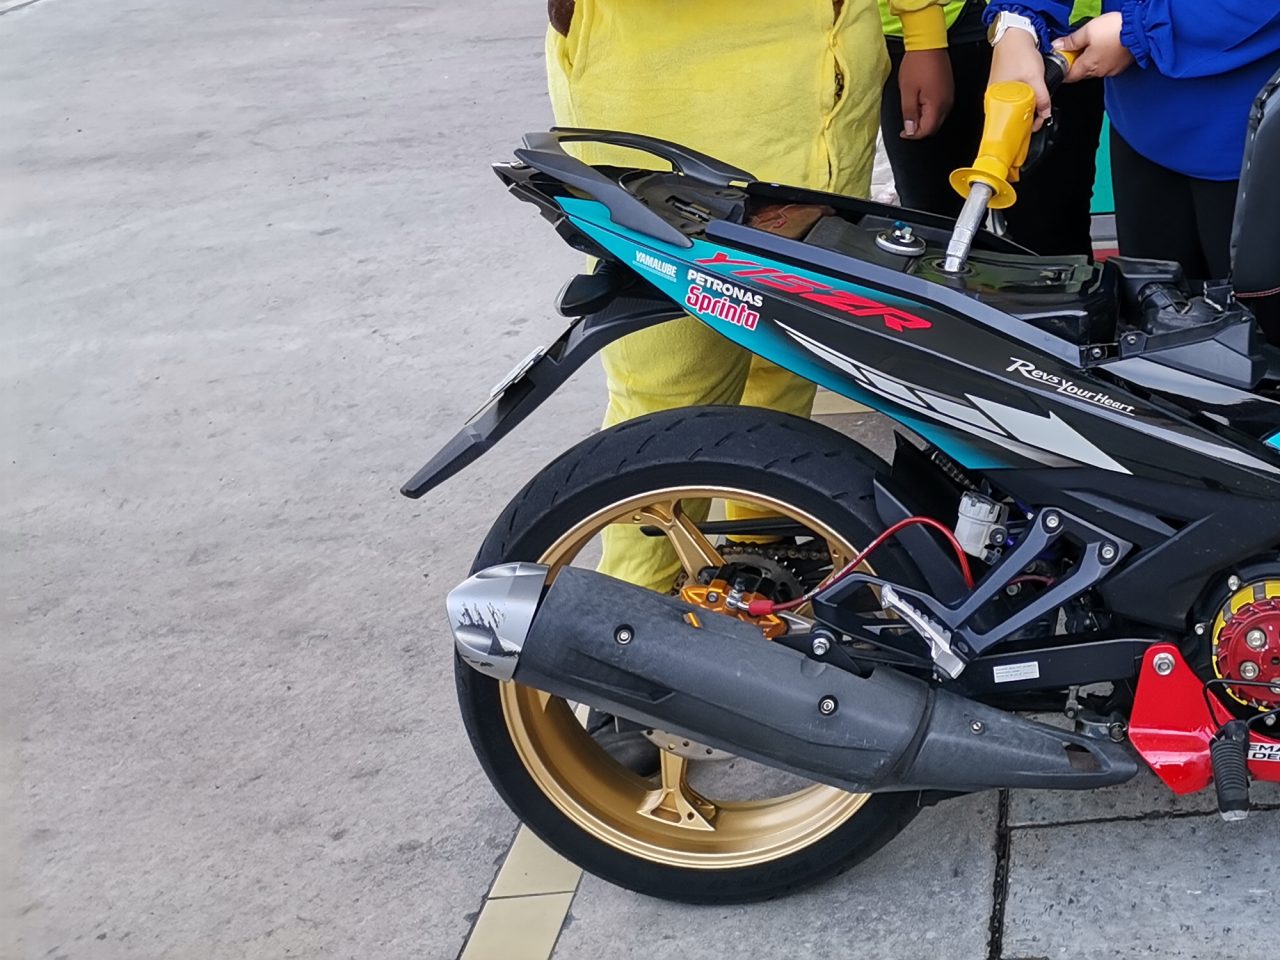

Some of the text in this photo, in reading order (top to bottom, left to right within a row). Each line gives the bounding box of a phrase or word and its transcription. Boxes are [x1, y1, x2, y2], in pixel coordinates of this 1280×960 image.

[635, 250, 677, 277] YAMALUBE
[687, 269, 763, 307] PETRONAS
[685, 284, 760, 331] Sprinta
